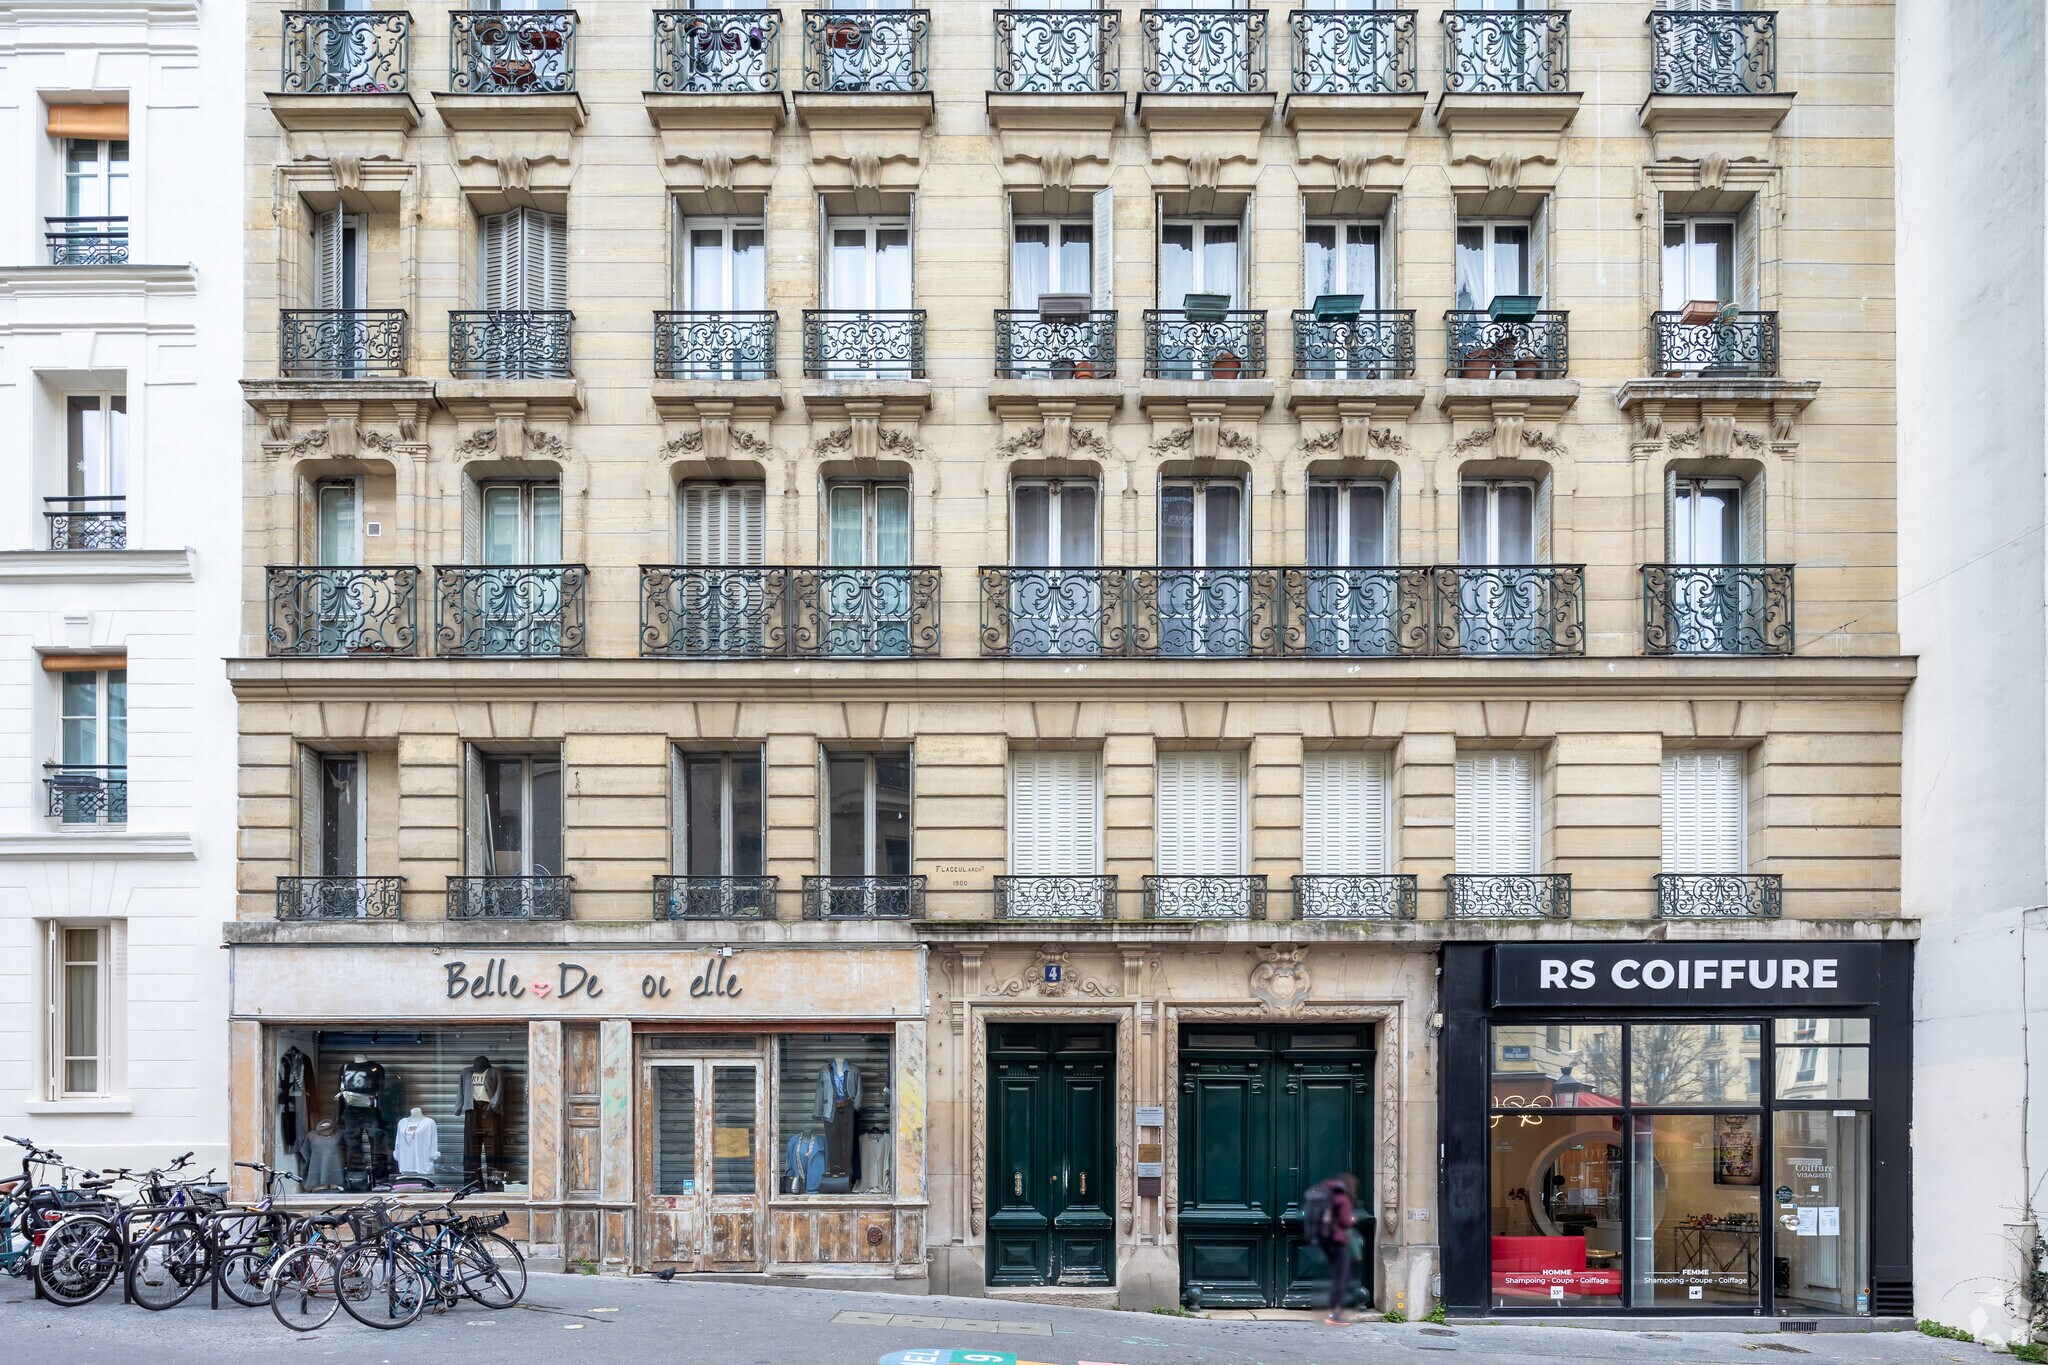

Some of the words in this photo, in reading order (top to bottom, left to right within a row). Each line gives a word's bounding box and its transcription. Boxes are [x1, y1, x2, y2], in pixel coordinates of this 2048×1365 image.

[444, 958, 526, 998] Belle
[558, 961, 603, 998] De
[689, 958, 742, 998] elle
[1048, 966, 1058, 981] 4
[1540, 959, 1596, 990] RS
[1611, 959, 1838, 990] COIFFURE
[344, 1070, 367, 1088] 76
[1795, 1164, 1834, 1172] Coiffure
[1505, 1277, 1546, 1285] Shampoing
[1551, 1277, 1575, 1285] Coupe
[1580, 1277, 1609, 1285] Coiffage
[1644, 1277, 1685, 1285] Shampoing
[1690, 1277, 1713, 1285] Coupe
[1718, 1277, 1748, 1285] Coiffage
